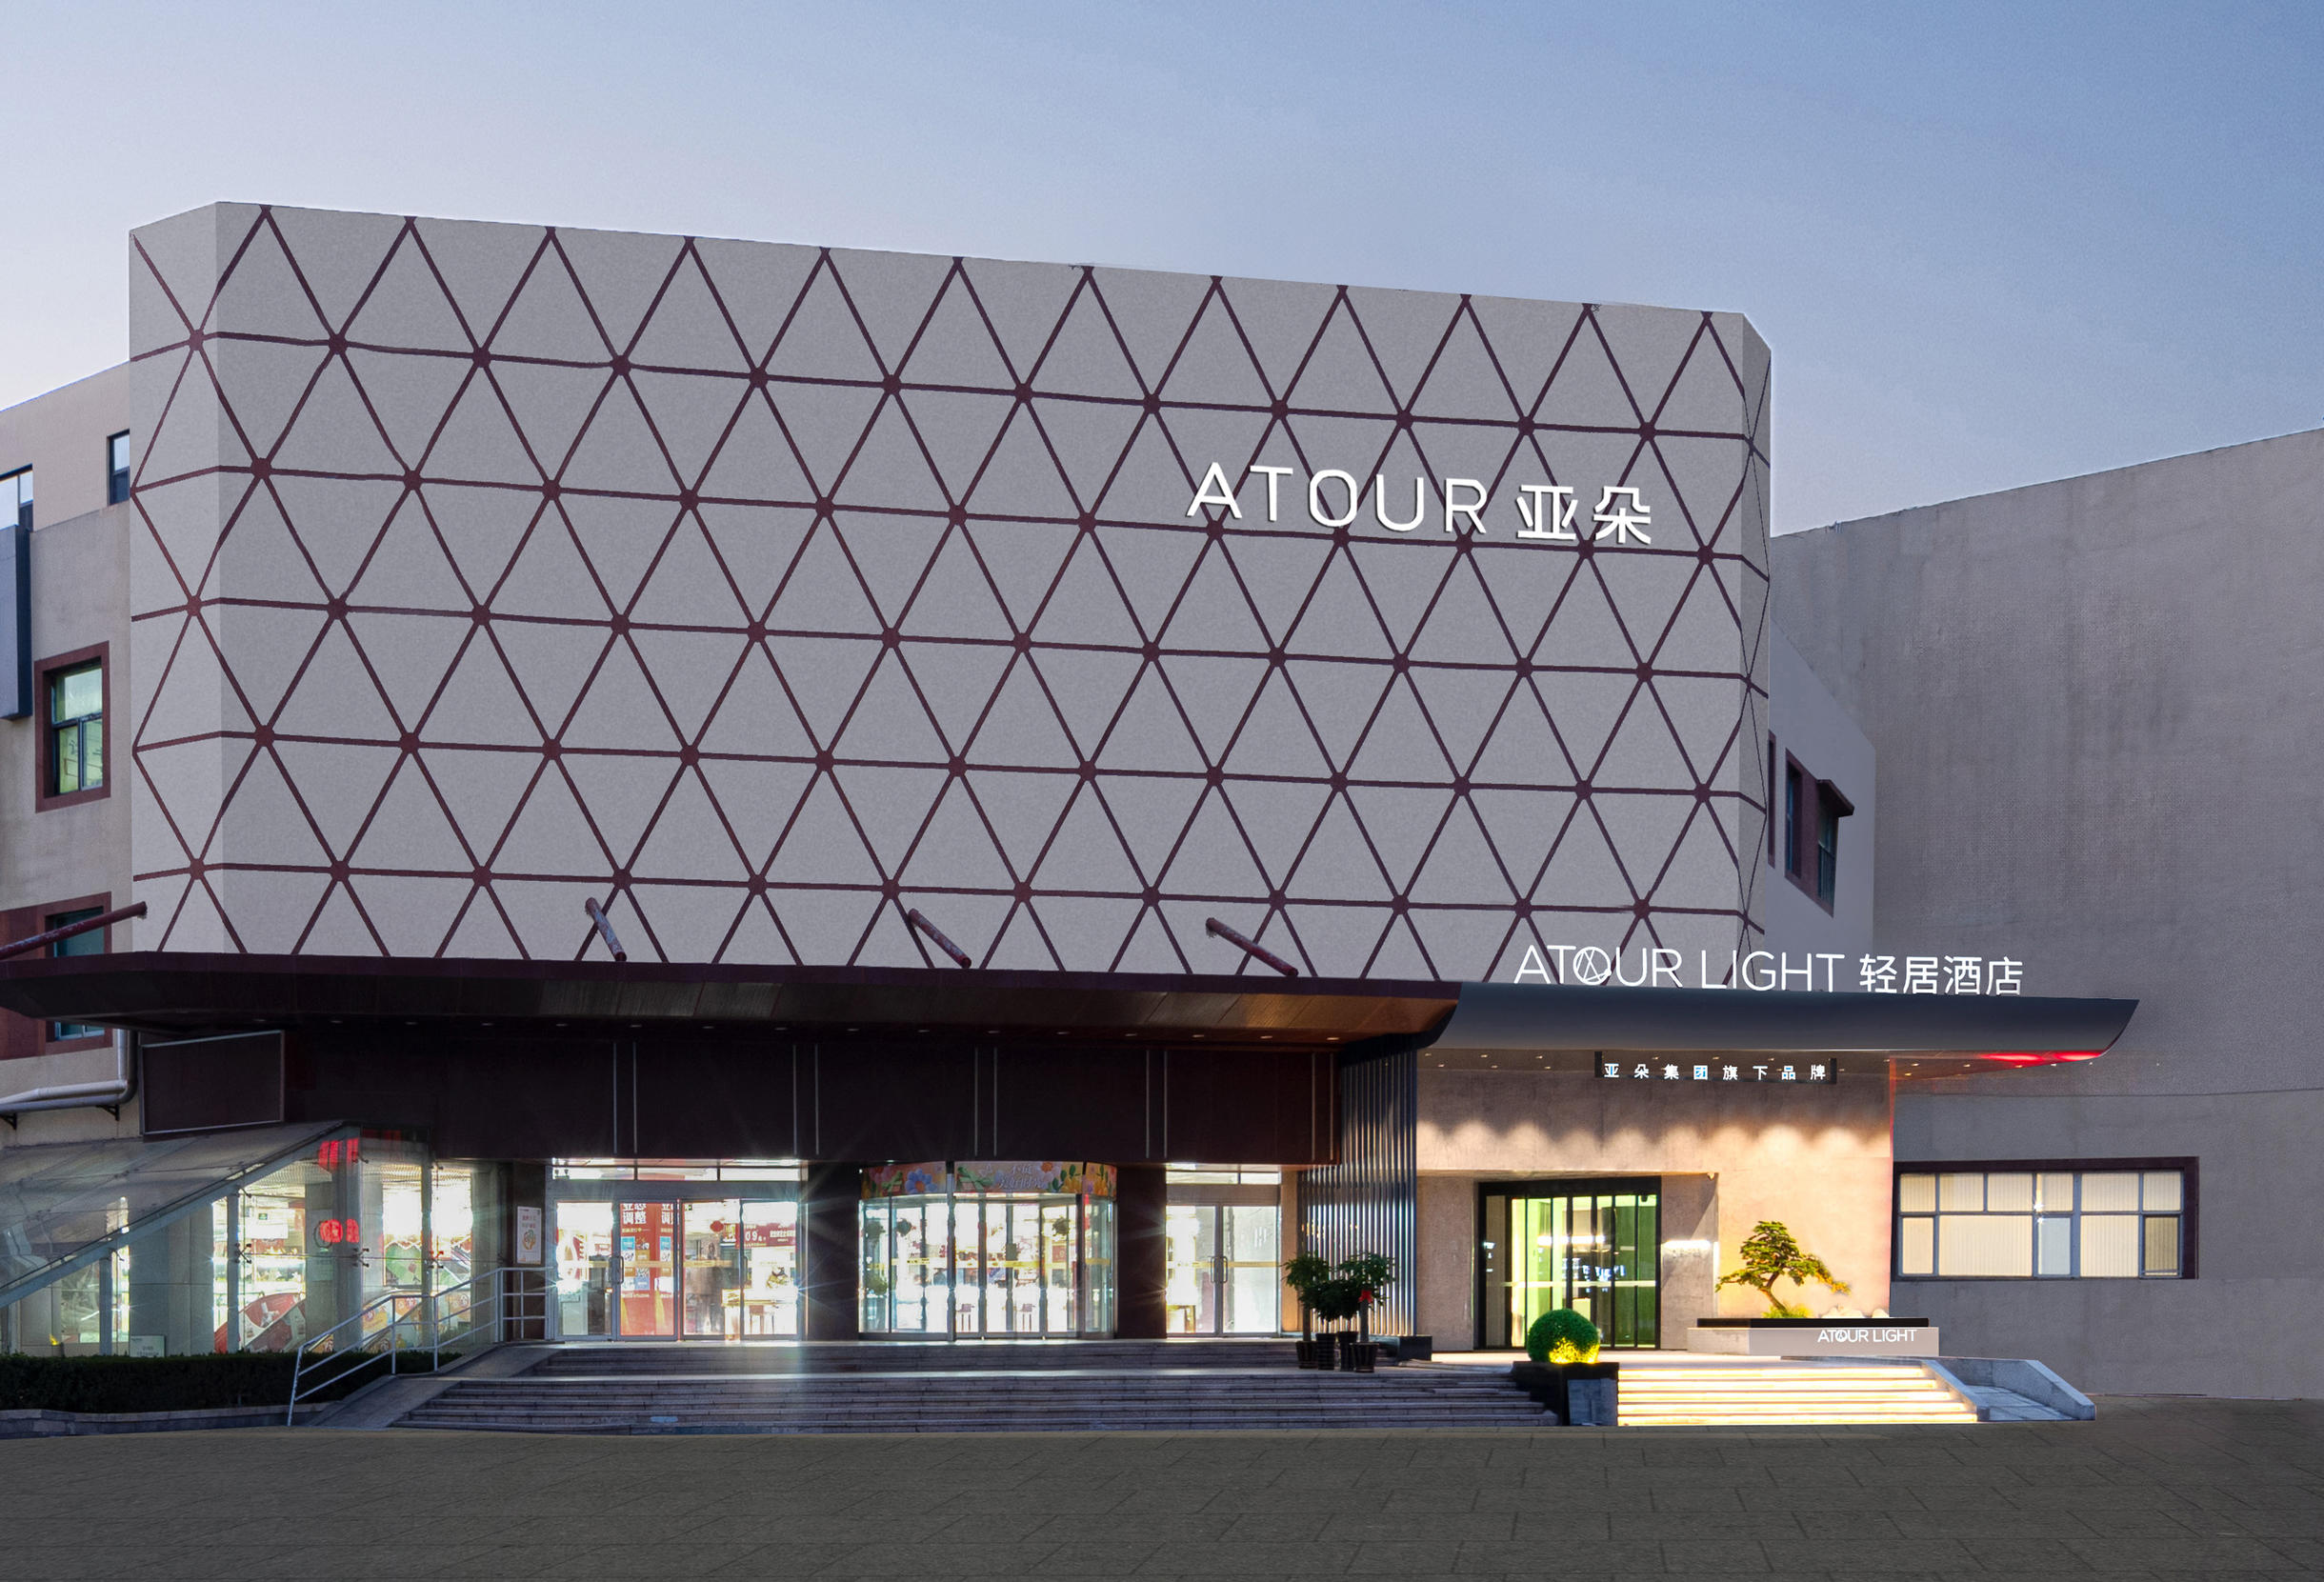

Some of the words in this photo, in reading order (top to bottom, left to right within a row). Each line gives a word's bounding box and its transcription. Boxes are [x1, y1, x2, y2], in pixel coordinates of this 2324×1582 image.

[1187, 462, 1487, 534] ATOUR
[1516, 484, 1653, 545] 亚朵
[1514, 944, 1683, 988] ATOUR
[1700, 950, 1845, 992] LIGHT
[1859, 953, 2023, 995] 轻居酒店
[1604, 1062, 1827, 1081] 亚朵集团旗下品牌
[1817, 1329, 1870, 1343] ATOUR
[1873, 1329, 1917, 1343] LIGHT
